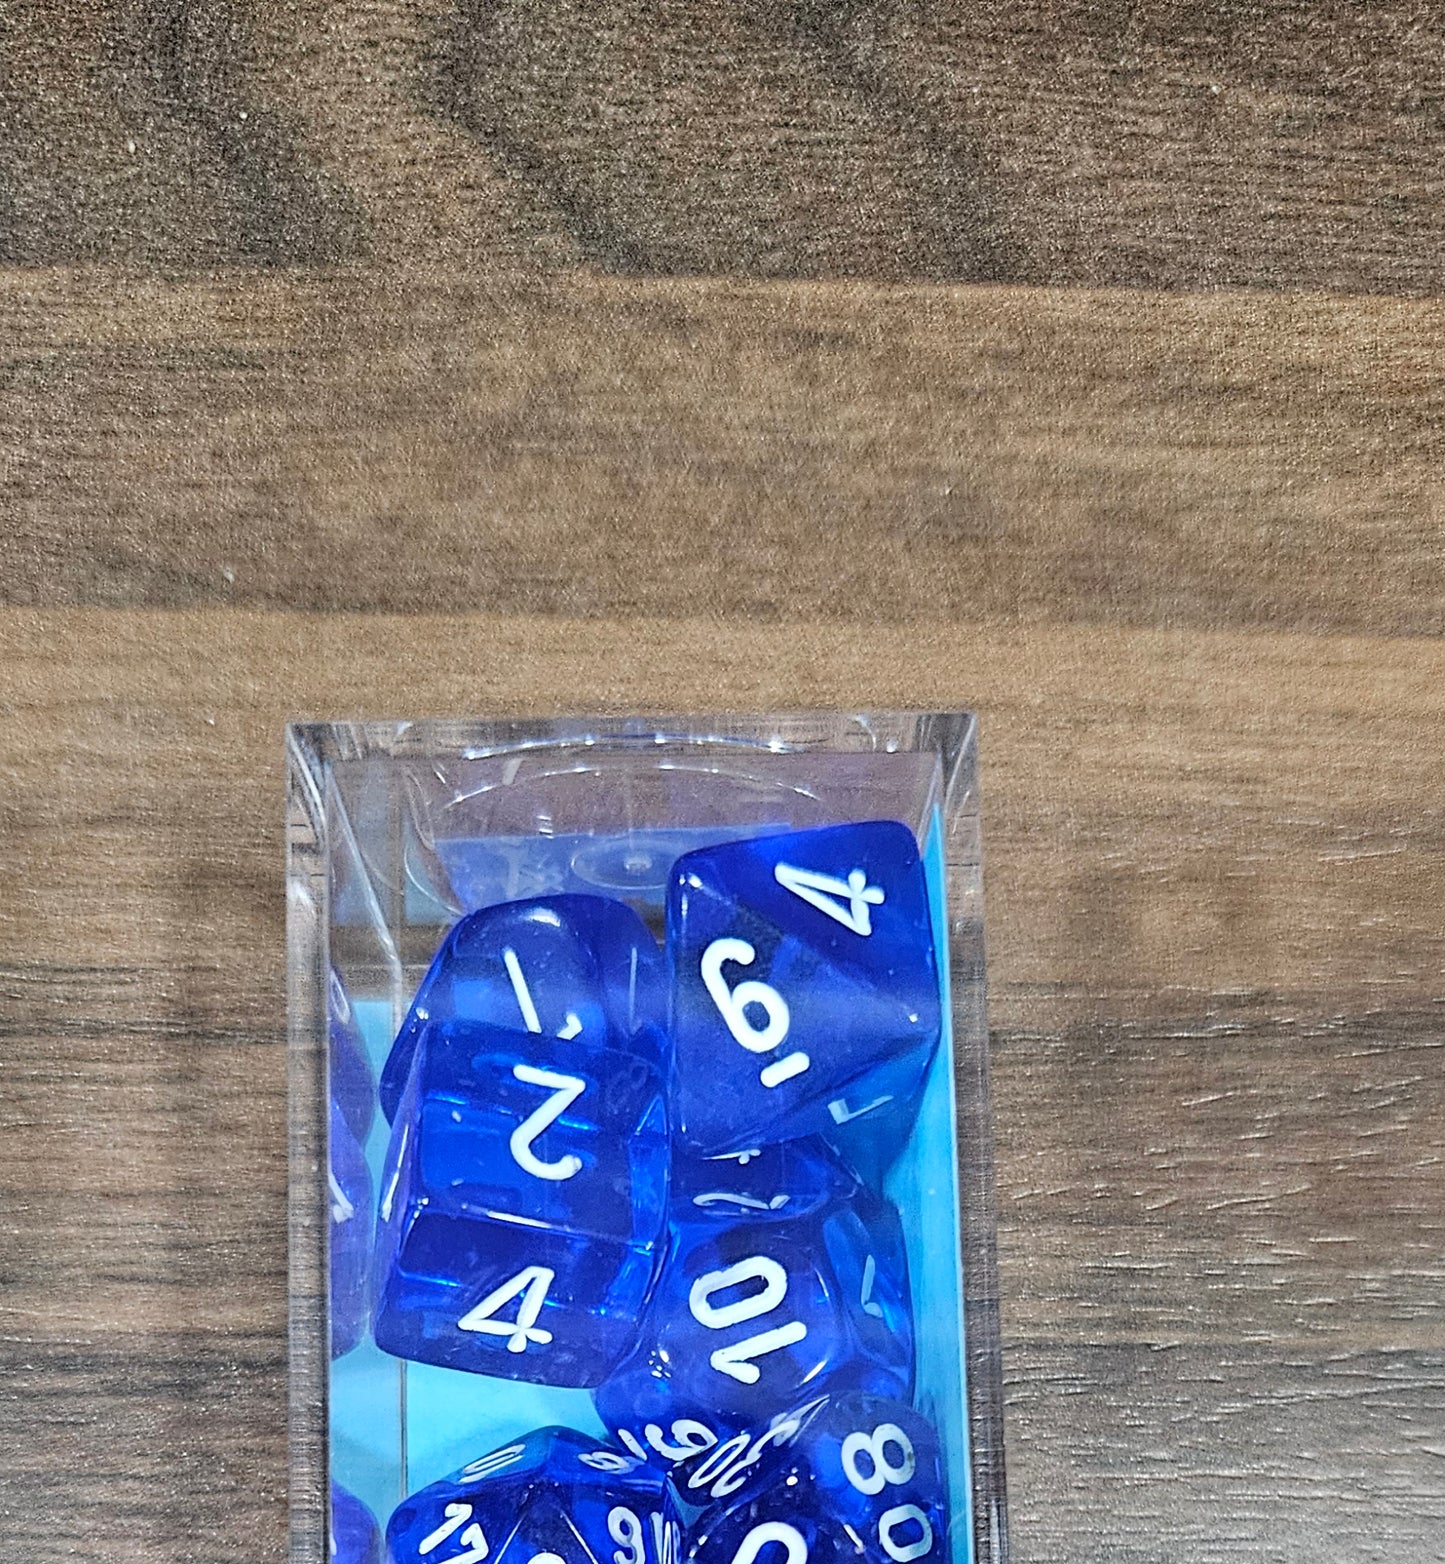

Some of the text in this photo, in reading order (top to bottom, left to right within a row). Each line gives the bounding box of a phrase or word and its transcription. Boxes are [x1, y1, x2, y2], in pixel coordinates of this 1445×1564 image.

[775, 861, 885, 936] 4
[510, 1064, 586, 1181] 2
[458, 1265, 555, 1353] 4
[689, 1255, 808, 1385] 10
[841, 1422, 933, 1563] 80
